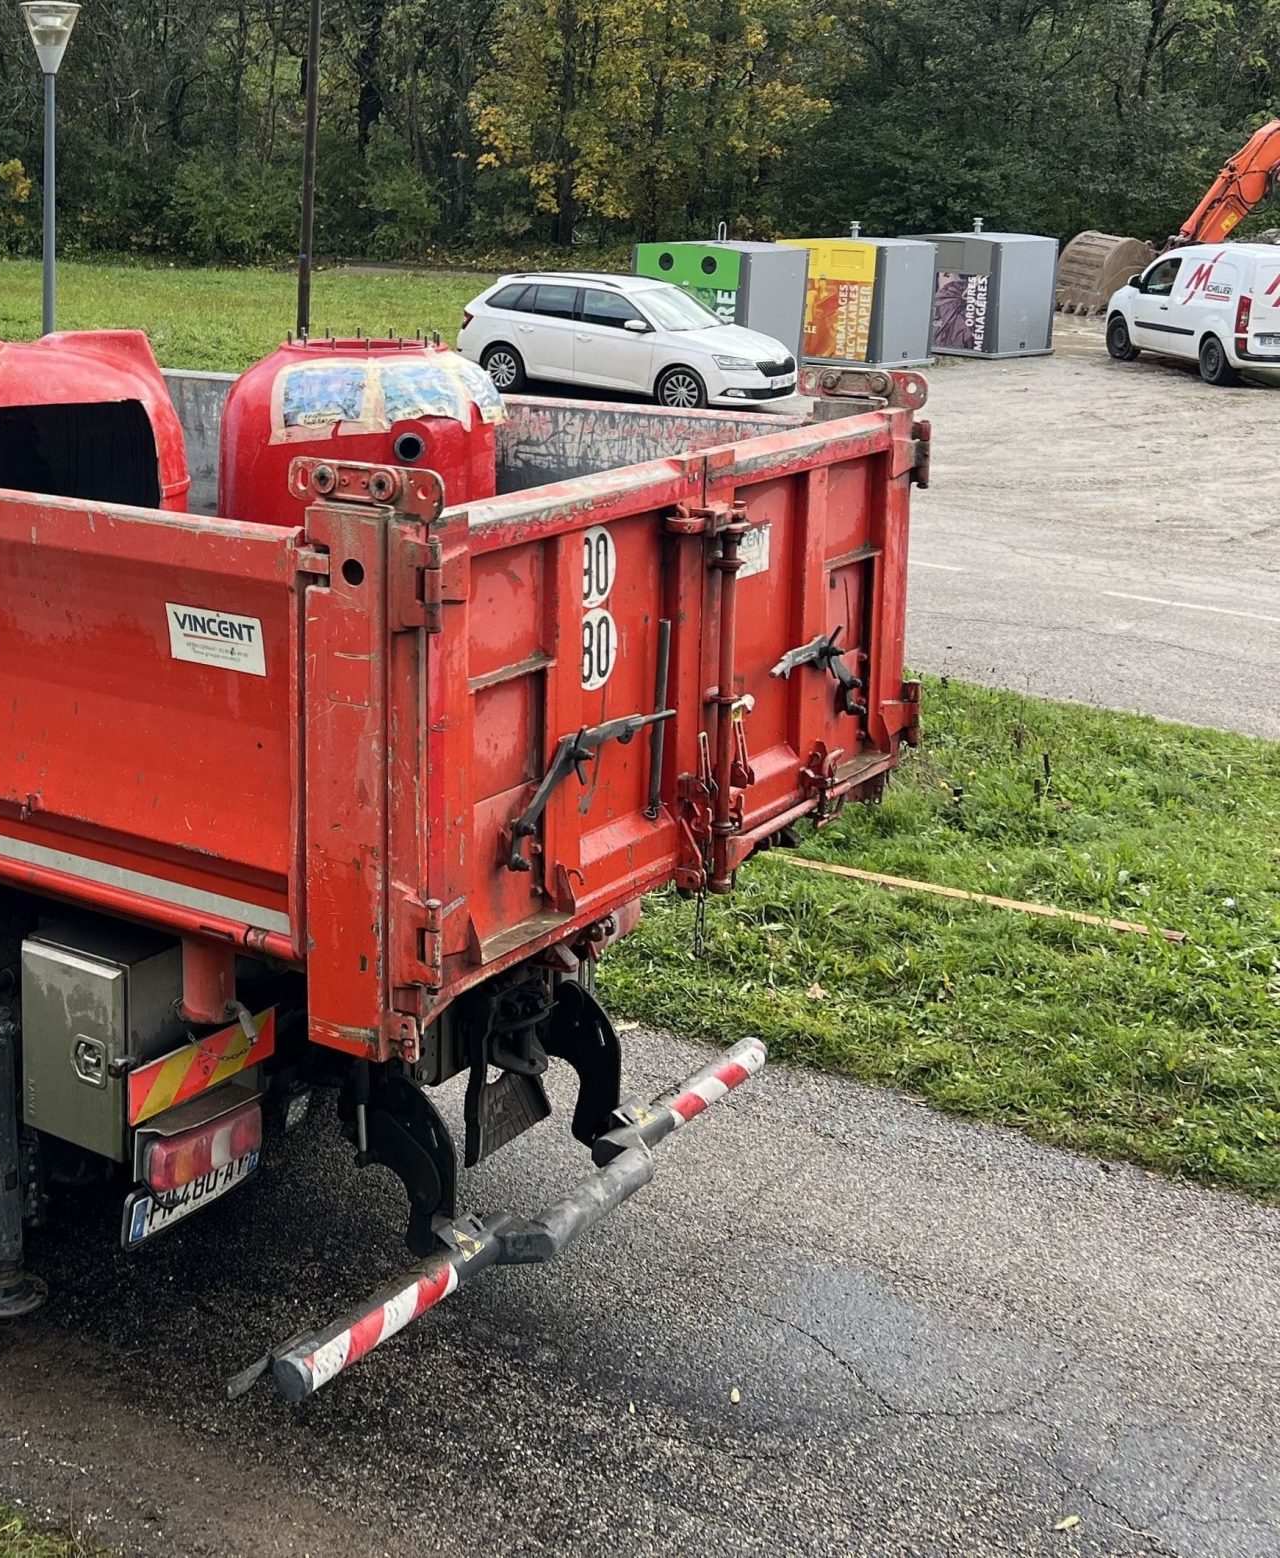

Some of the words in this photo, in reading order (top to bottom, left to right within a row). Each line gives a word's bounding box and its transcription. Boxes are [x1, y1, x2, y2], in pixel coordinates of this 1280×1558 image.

[835, 284, 848, 355] EMBALLAGES
[858, 286, 872, 334] PAPIER
[965, 276, 977, 327] ORDURES
[856, 336, 869, 353] ET
[173, 611, 255, 642] VINCENT
